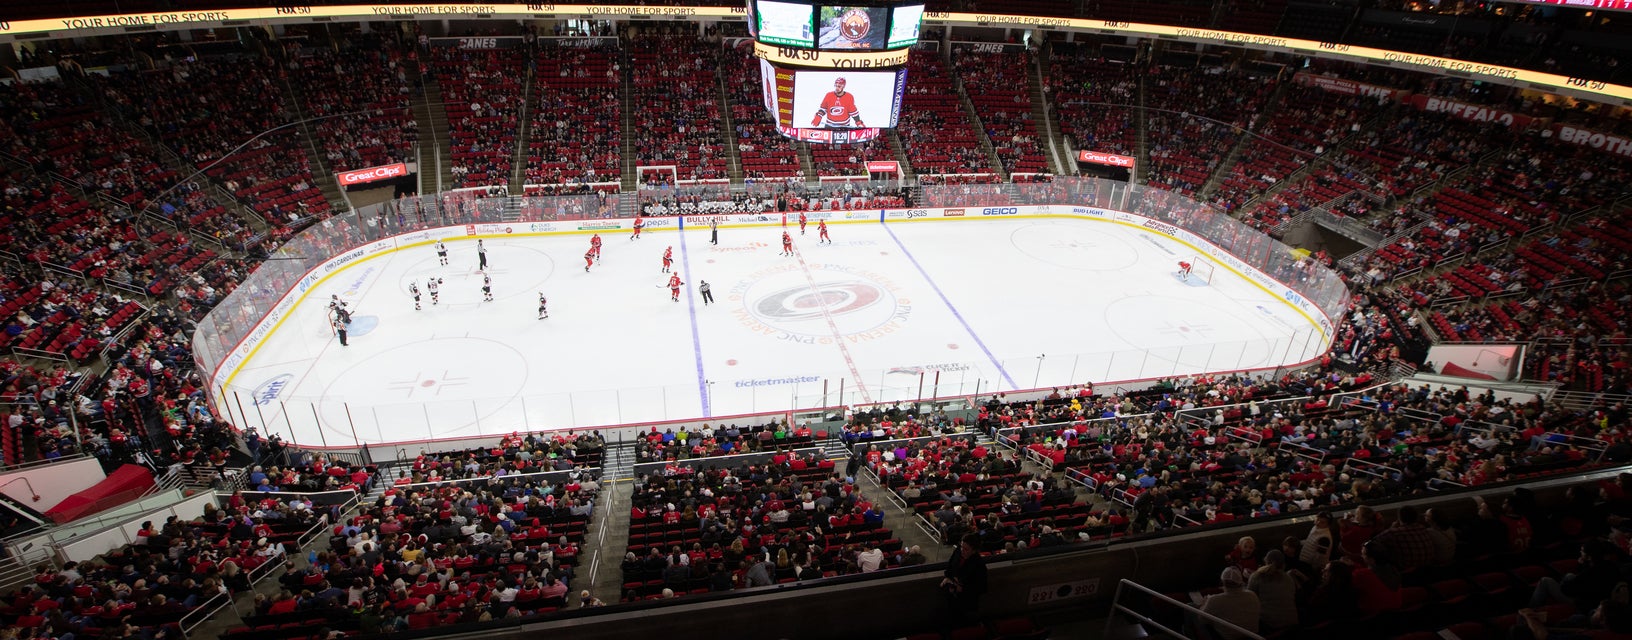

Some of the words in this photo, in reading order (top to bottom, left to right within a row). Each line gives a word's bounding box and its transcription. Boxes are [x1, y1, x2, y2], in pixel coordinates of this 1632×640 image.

[276, 7, 297, 15] FOX
[298, 6, 311, 14] 50
[372, 7, 401, 15] YOUR
[404, 6, 435, 14] HOME
[438, 6, 457, 14] FOR
[460, 6, 496, 14] SPORTS
[586, 7, 610, 15] YOUR
[612, 7, 640, 15] HOME
[644, 7, 661, 15] FOR
[664, 8, 696, 16] SPORTS
[730, 6, 746, 14] FOX
[62, 19, 103, 30] YOUR
[106, 16, 149, 27] HOME
[154, 14, 179, 25] FOR
[182, 12, 229, 22] SPORTS
[975, 15, 997, 23] YOUR
[998, 16, 1022, 24] HOME
[1025, 17, 1040, 25] FOR
[1042, 18, 1071, 27] SPORTS
[1104, 20, 1118, 28] FOX
[0, 23, 10, 31] 0
[1176, 28, 1199, 38] YOUR
[1202, 31, 1230, 41] HOME
[1232, 33, 1251, 43] FOR
[1253, 36, 1287, 47] SPORTS
[459, 38, 497, 49] CANES
[971, 43, 1004, 53] CANES
[1319, 41, 1337, 50] FOX
[1338, 44, 1350, 52] 50
[778, 48, 800, 60] FOX
[802, 50, 819, 61] 50
[832, 58, 871, 68] YOUR
[875, 56, 902, 67] HOME
[1383, 52, 1412, 63] YOUR
[1414, 56, 1447, 68] HOME
[1450, 61, 1472, 72] FOR
[1475, 65, 1518, 79] SPORTS
[1567, 76, 1589, 88] FOX
[1591, 80, 1606, 91] 50
[1359, 84, 1392, 100] THE
[1425, 97, 1514, 127] BUFFALO
[1559, 126, 1632, 157] BROTH
[1084, 152, 1107, 162] Great
[1108, 156, 1129, 166] Clips
[345, 171, 375, 182] Great
[376, 166, 399, 178] Clips
[912, 209, 928, 217] sas
[983, 207, 1018, 215] GEICO
[1086, 209, 1104, 217] LIGHT
[647, 218, 670, 227] pepsi
[1146, 219, 1169, 230] Advance
[310, 271, 319, 281] NC
[1300, 301, 1309, 311] NC
[735, 375, 820, 388] ticketmaster
[1032, 590, 1053, 602] 221
[1074, 583, 1096, 595] 220
